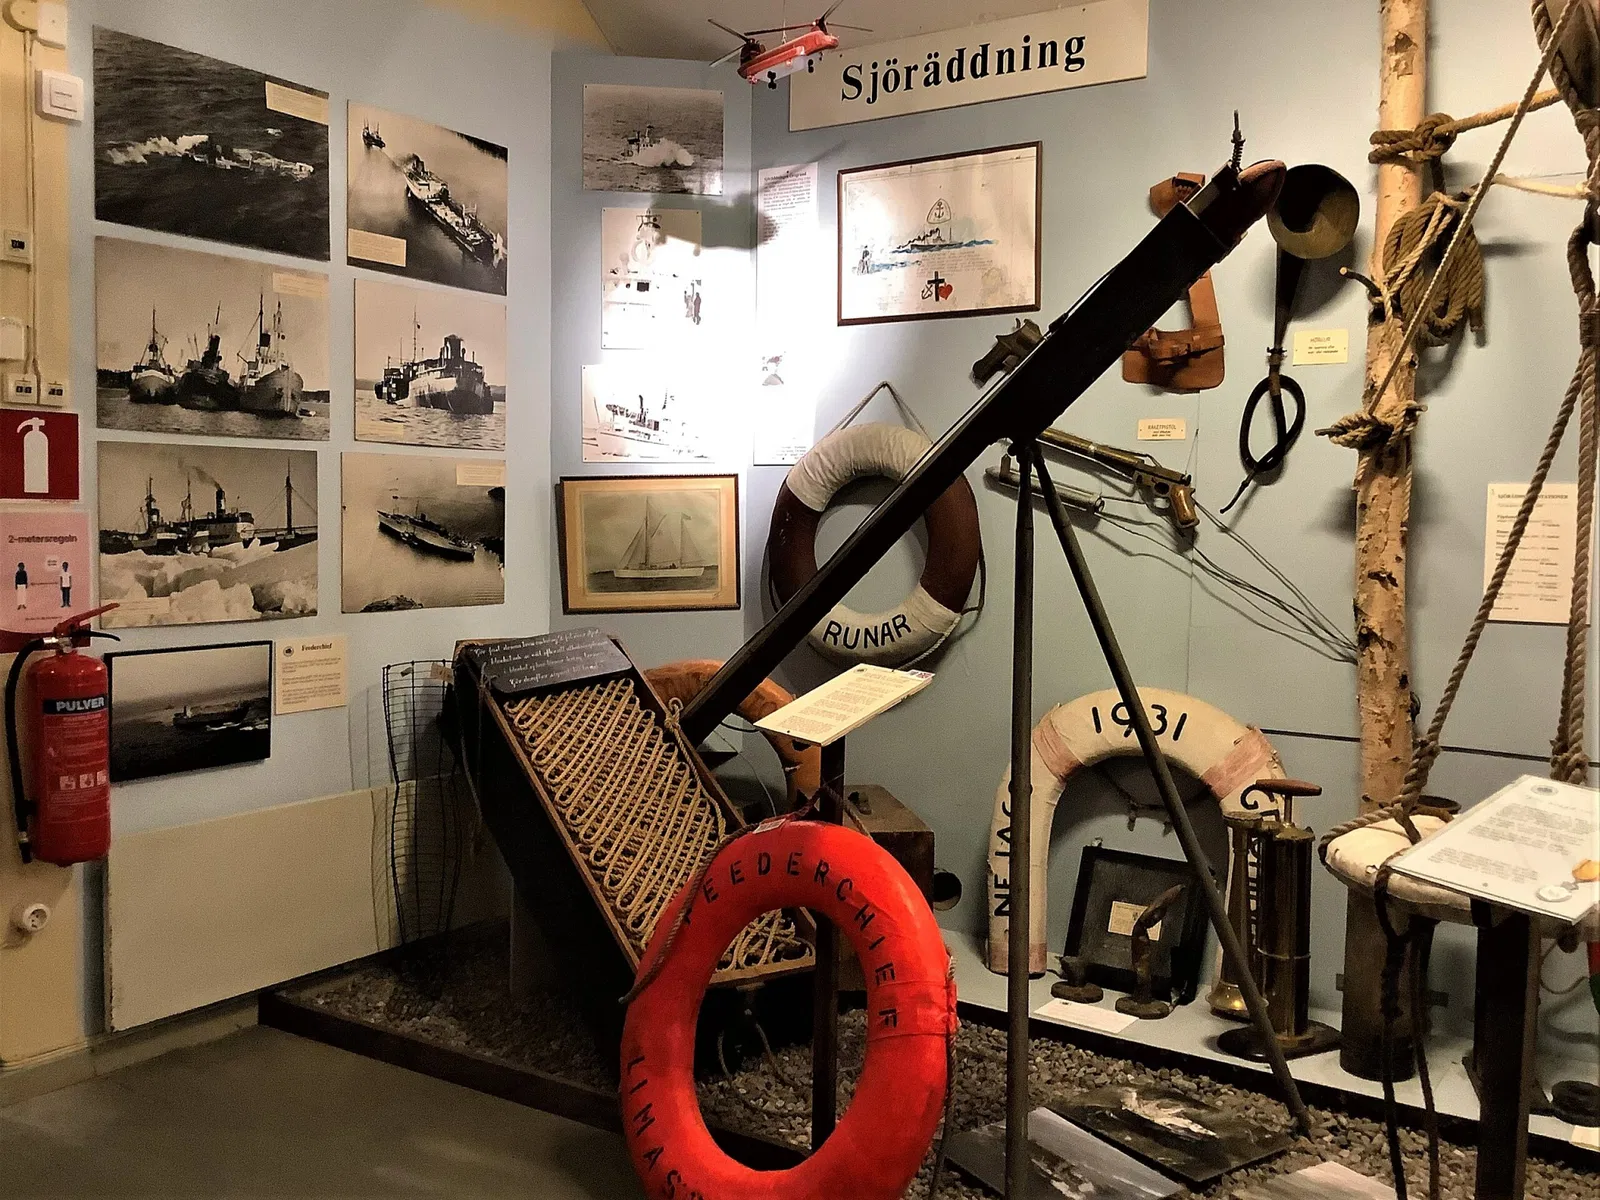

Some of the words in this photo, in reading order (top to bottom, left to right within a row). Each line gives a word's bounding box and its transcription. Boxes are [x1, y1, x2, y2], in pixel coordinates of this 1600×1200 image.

[841, 34, 1087, 104] Sjöräddning
[8, 534, 78, 545] 2-metersregeln
[822, 613, 912, 650] RUNAR
[56, 697, 105, 712] PULVER
[1092, 701, 1188, 741] 1931
[683, 851, 898, 1029] EEDERCHIEF
